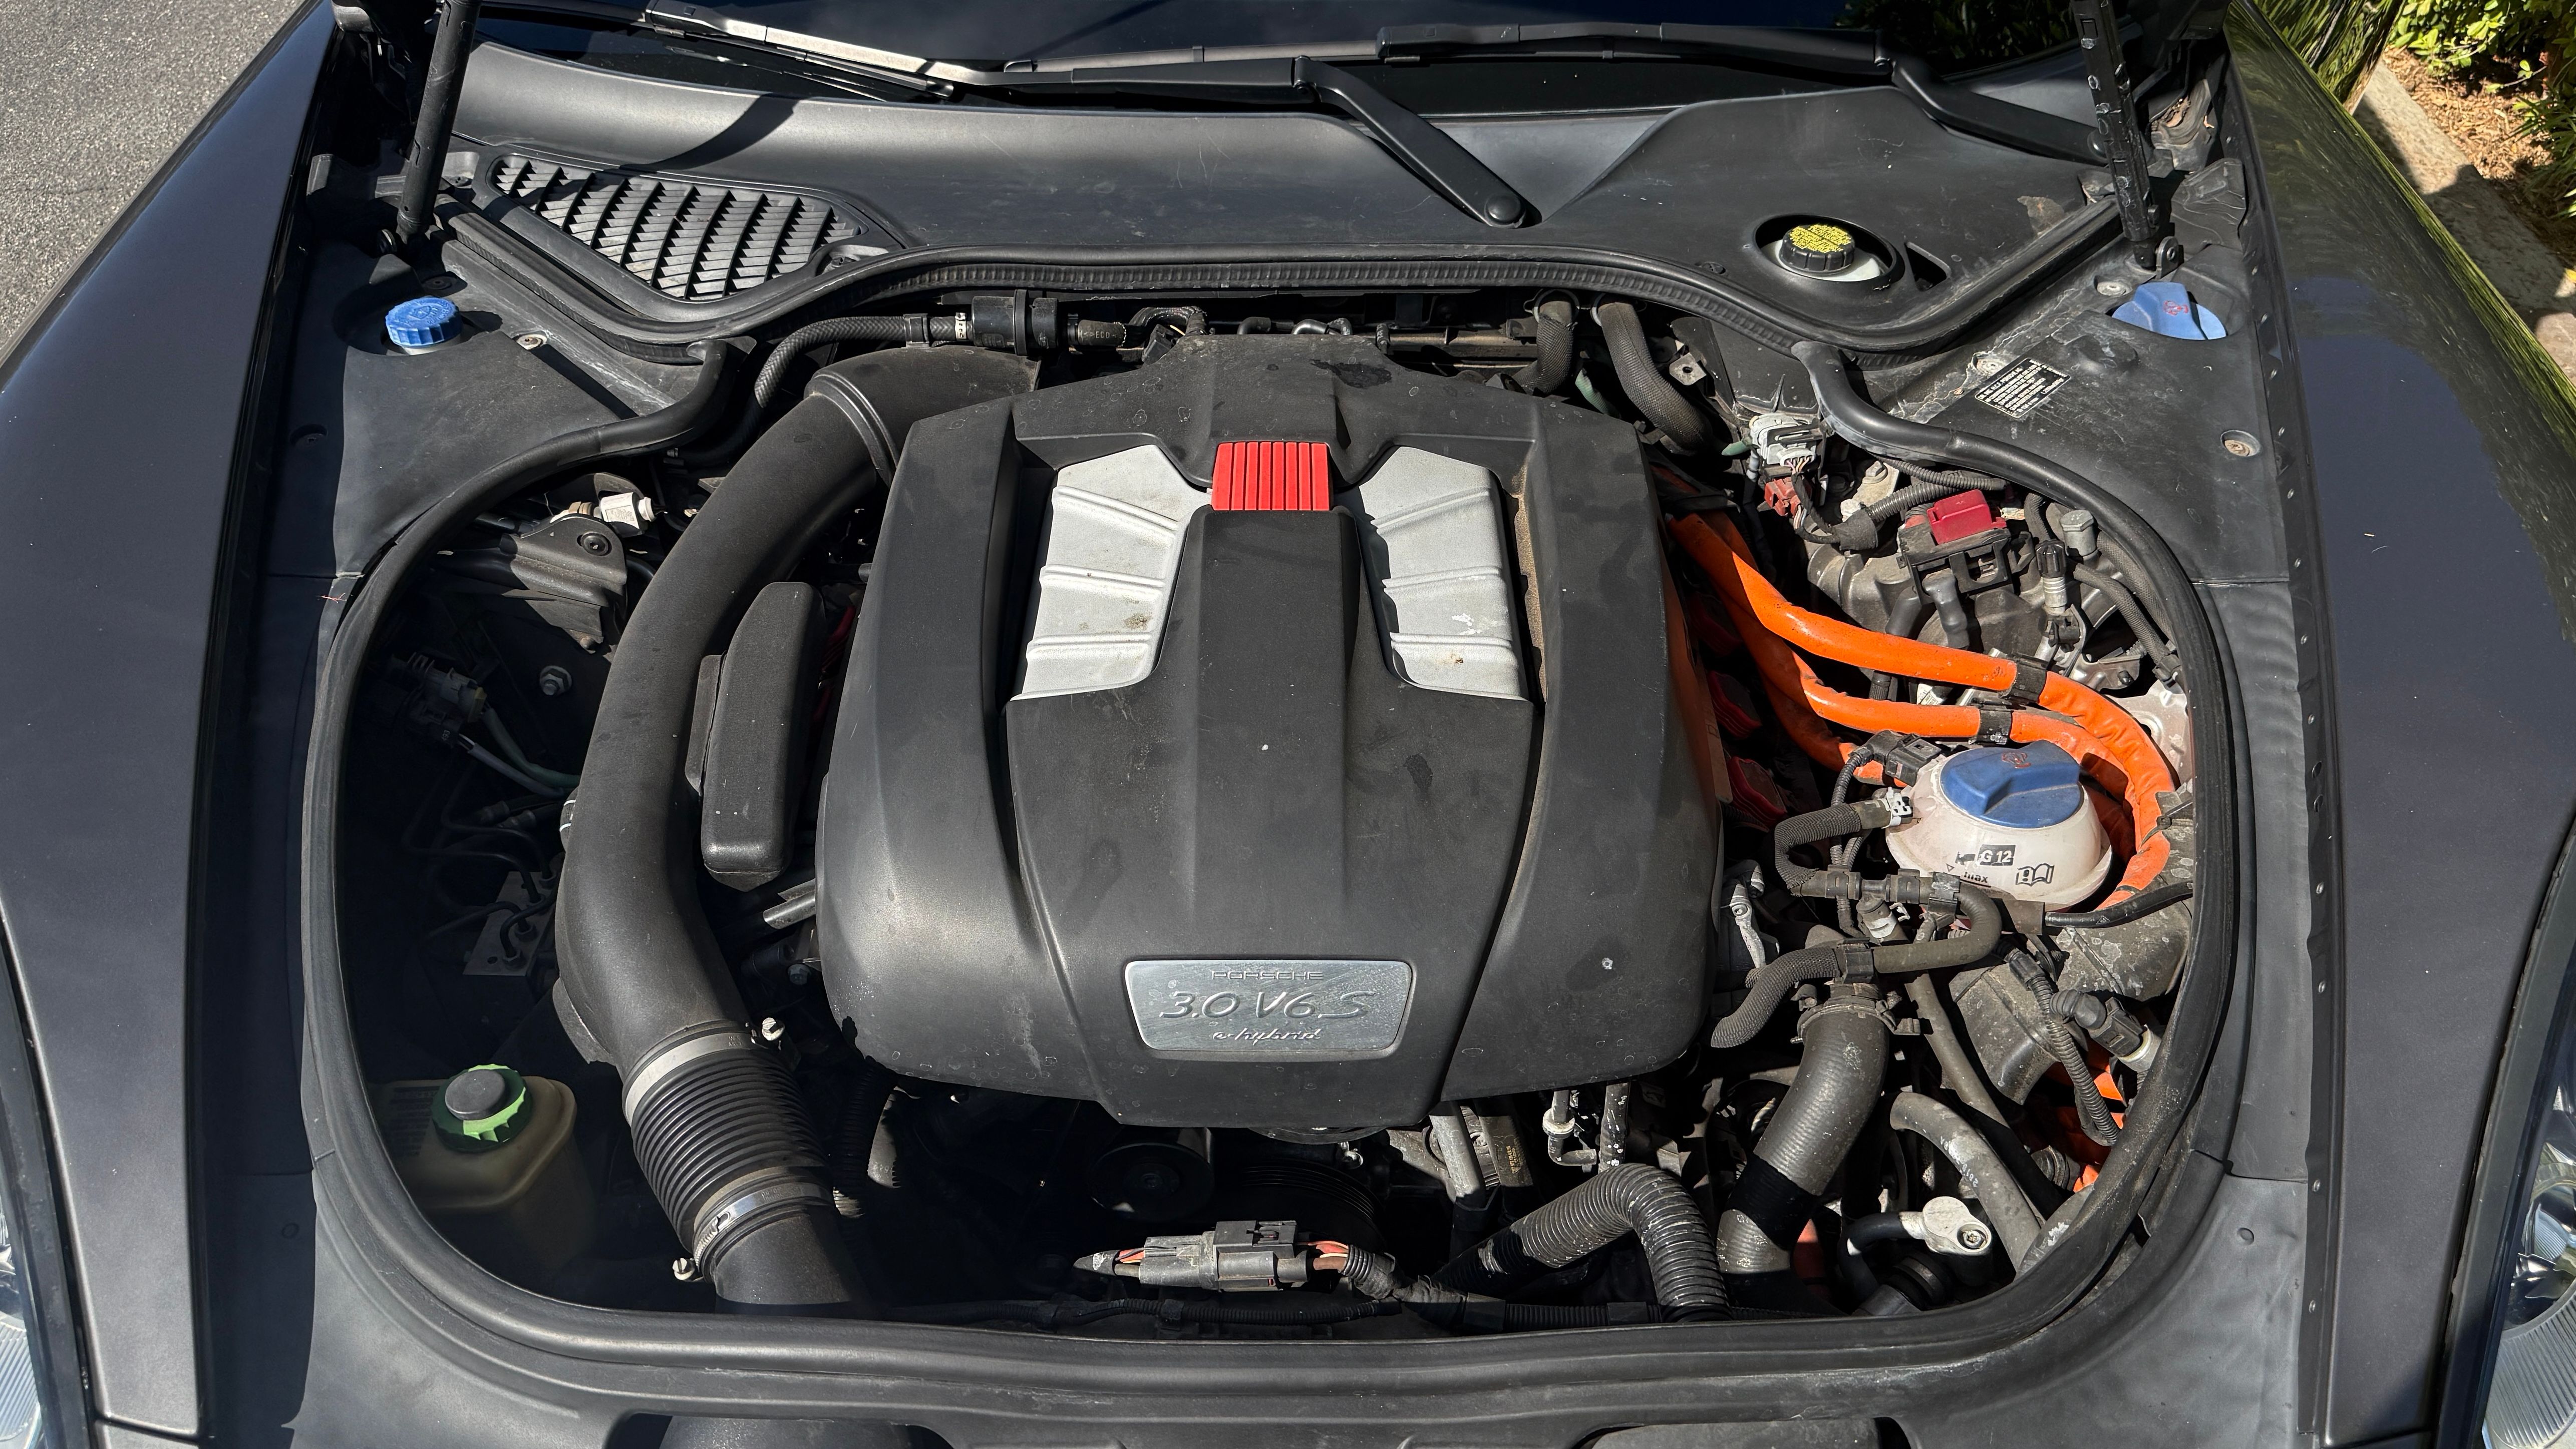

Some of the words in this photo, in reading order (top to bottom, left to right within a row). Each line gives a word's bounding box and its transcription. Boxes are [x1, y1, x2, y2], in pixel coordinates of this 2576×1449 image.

[1211, 970, 1324, 980] PORSCHE
[1159, 991, 1240, 1018] 3.0
[1256, 991, 1315, 1018] V6
[1318, 991, 1377, 1019] S
[1212, 1027, 1322, 1046] e-hybrid
